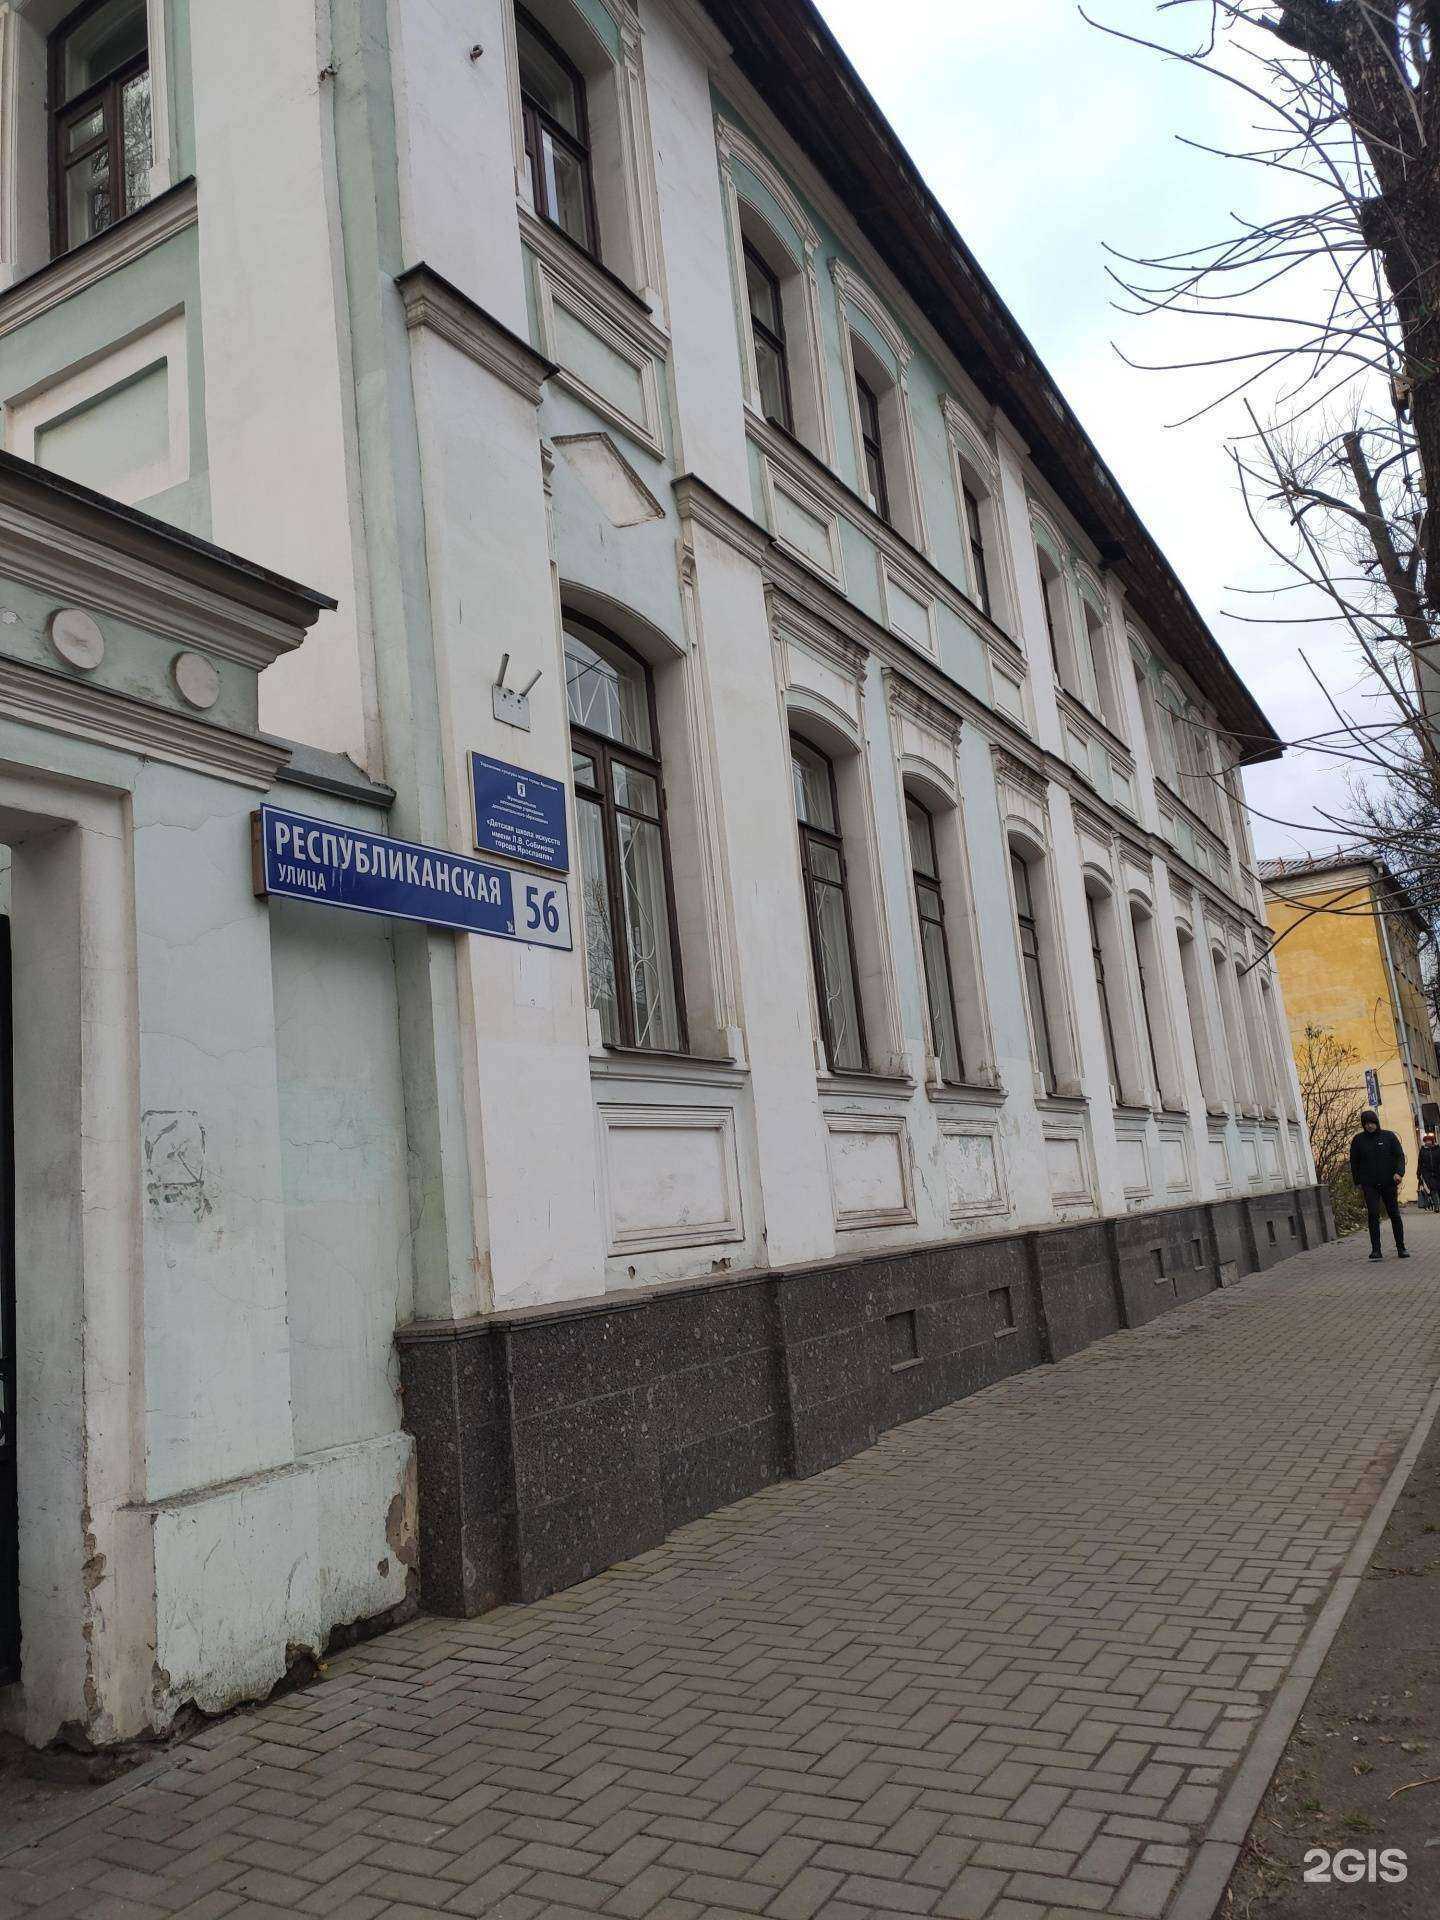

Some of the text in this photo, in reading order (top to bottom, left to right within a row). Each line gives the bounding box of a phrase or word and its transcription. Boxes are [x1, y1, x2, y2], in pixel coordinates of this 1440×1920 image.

[486, 818, 561, 846] «Детская школа искусств
[491, 830, 512, 842] имени
[525, 839, 555, 854] Собинова
[495, 840, 517, 852] города
[274, 821, 502, 906] РЕСПУБЛИКАНСКАЯ
[277, 863, 326, 893] УЛИЦА
[525, 885, 560, 934] 56
